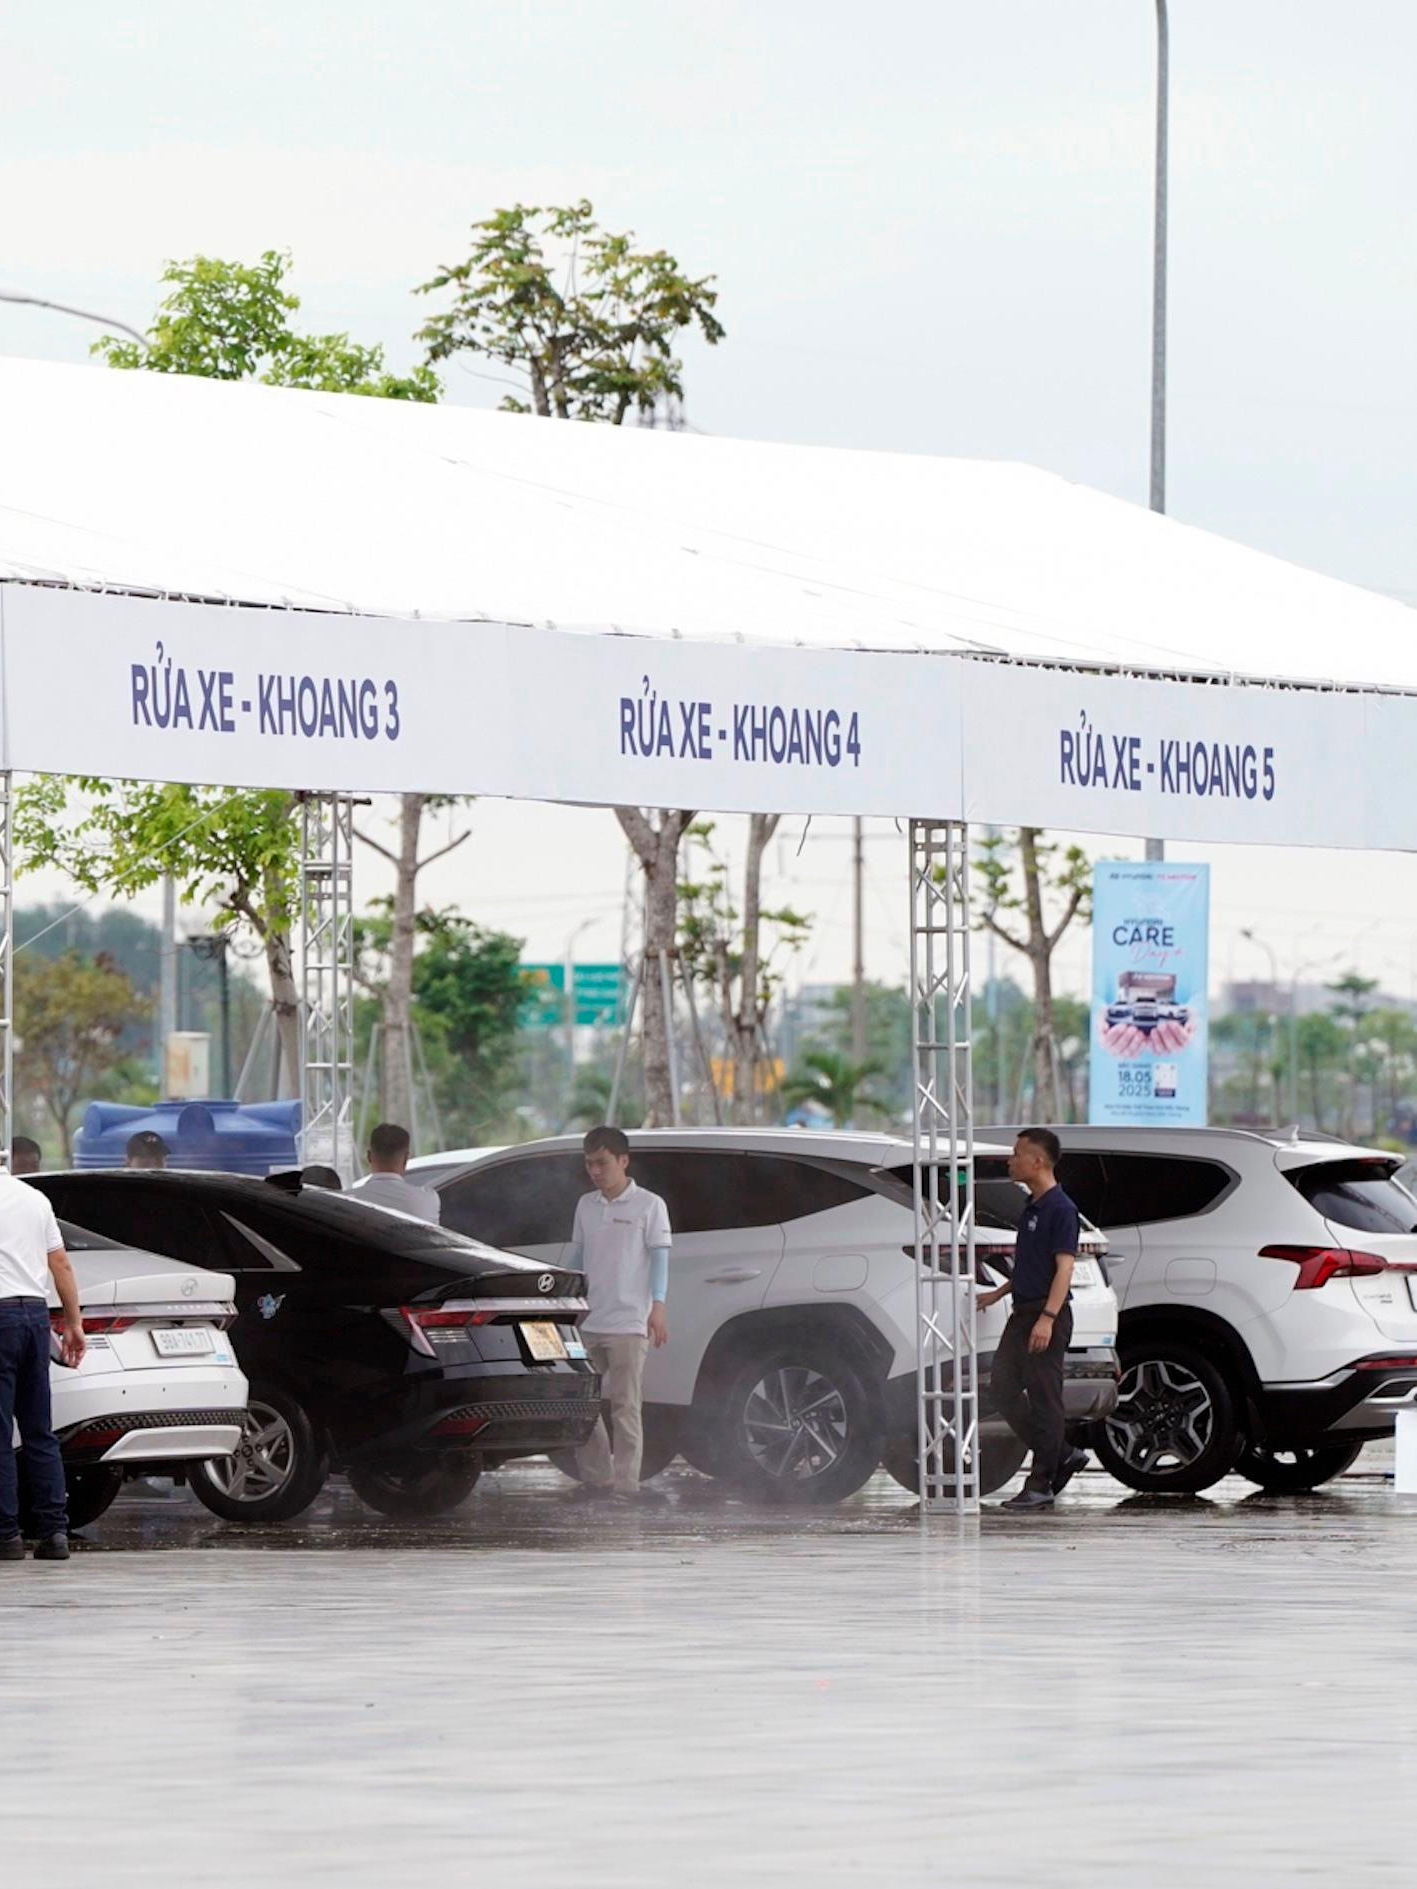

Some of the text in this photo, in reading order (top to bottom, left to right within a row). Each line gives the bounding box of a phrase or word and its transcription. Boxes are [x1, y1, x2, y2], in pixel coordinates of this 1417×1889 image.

[130, 640, 194, 729] RỬA
[197, 670, 236, 733] XE
[257, 673, 379, 741] KHOANG
[383, 679, 401, 742] 3
[619, 674, 676, 758] RỬA
[679, 701, 713, 761] XE
[733, 703, 842, 768] KHOANG
[845, 710, 863, 768] 4
[1059, 708, 1109, 788] RỬA
[1112, 735, 1142, 792] XE
[1159, 739, 1258, 800] KHOANG
[1262, 746, 1275, 801] 5
[1112, 926, 1174, 946] CARE
[1118, 1070, 1152, 1083] 18.05
[1118, 1084, 1152, 1097] 2025
